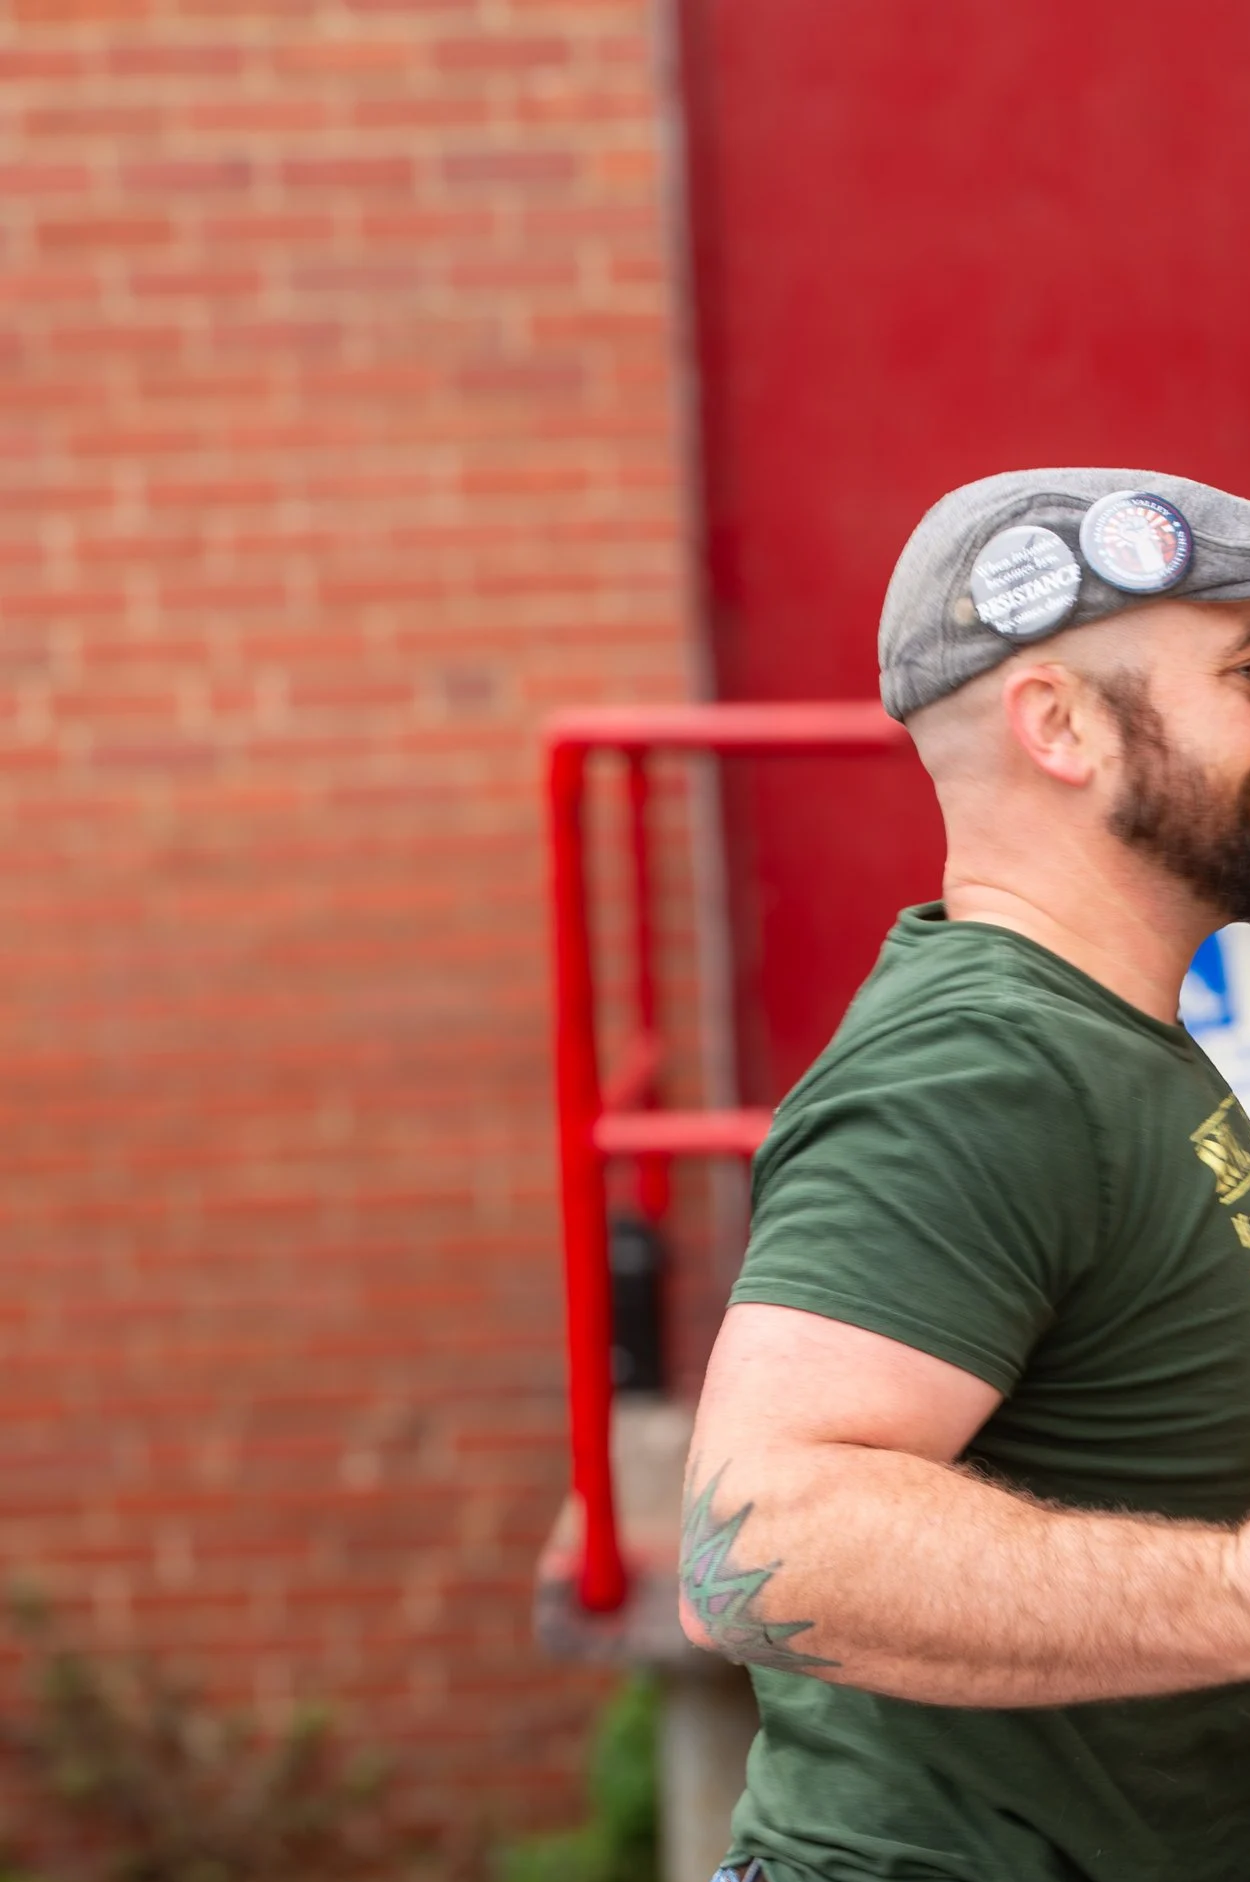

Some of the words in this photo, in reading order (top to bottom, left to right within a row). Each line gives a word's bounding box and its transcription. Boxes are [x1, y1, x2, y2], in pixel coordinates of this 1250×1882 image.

[1131, 498, 1173, 518] VALLEY
[974, 557, 1013, 580] When
[975, 562, 1082, 625] RESISTANCE
